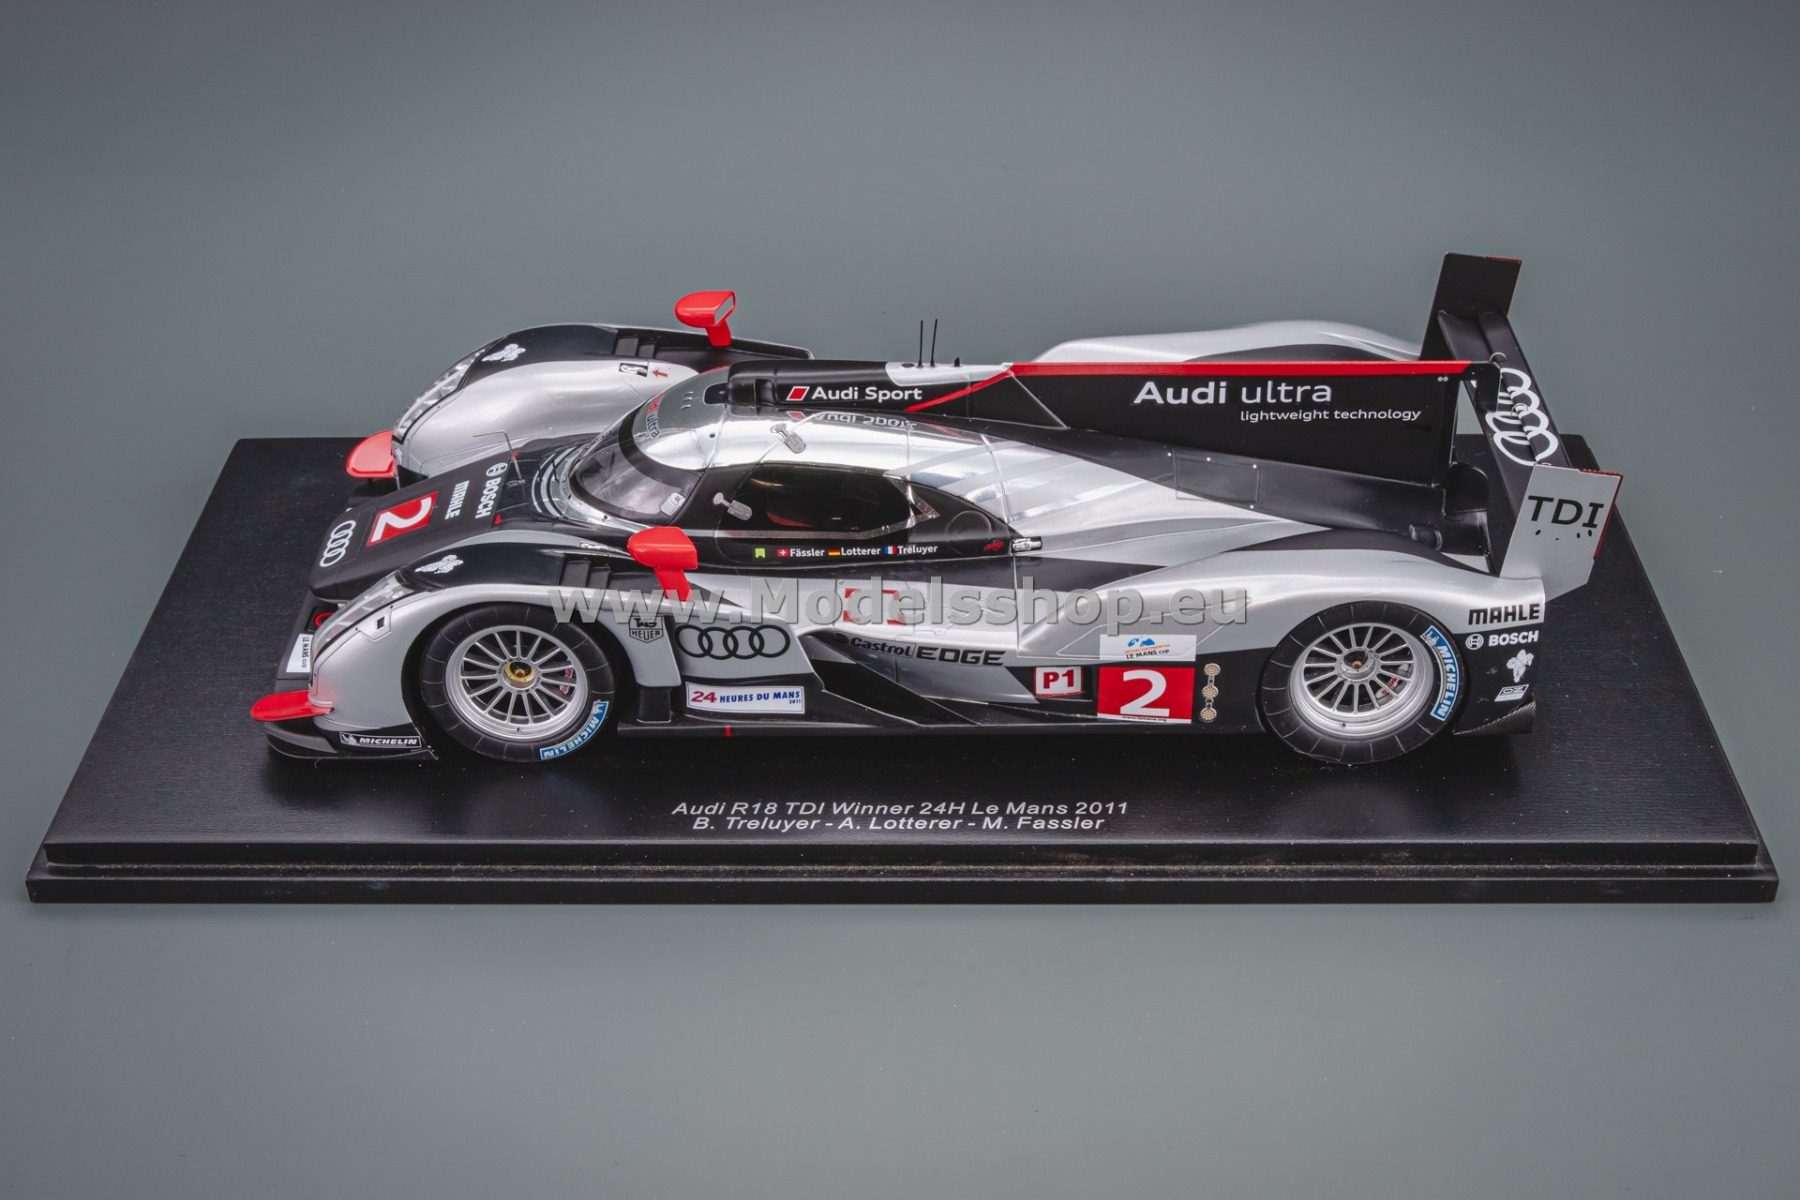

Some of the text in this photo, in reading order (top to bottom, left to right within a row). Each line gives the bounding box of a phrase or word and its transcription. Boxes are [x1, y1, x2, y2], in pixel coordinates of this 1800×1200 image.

[811, 386, 922, 403] Audi Sport
[1133, 381, 1332, 404] Audi ultra
[647, 414, 660, 438] ultra
[1240, 409, 1421, 423] lightweight technology
[445, 480, 470, 520] MAHLE
[475, 477, 502, 519] BOSCH
[371, 496, 433, 543] 2
[1527, 495, 1605, 529] TDI
[790, 545, 938, 557] Fässler Lotterer Tréluyer
[1468, 603, 1541, 625] MAHLE
[631, 630, 661, 641] HEUER
[1488, 631, 1539, 647] BOSCH
[850, 637, 1006, 666] Castrol EDGE
[1136, 649, 1157, 657] MANS
[1043, 669, 1076, 689] P1
[1436, 645, 1457, 719] MICHELIN
[691, 691, 800, 703] 24 HEURES DU MANS
[1120, 669, 1170, 717] 2
[359, 736, 418, 746] MICHELIN
[543, 716, 600, 758] MICHELIN
[672, 802, 1128, 815] Audi R18 TDI Winner 24H Le Mans 2011
[692, 817, 715, 830] B.
[725, 817, 820, 833] Treluyer
[838, 817, 860, 830] A.
[869, 817, 963, 830] Lotterer
[982, 817, 1009, 830] M.
[1016, 817, 1105, 830] Fassler
